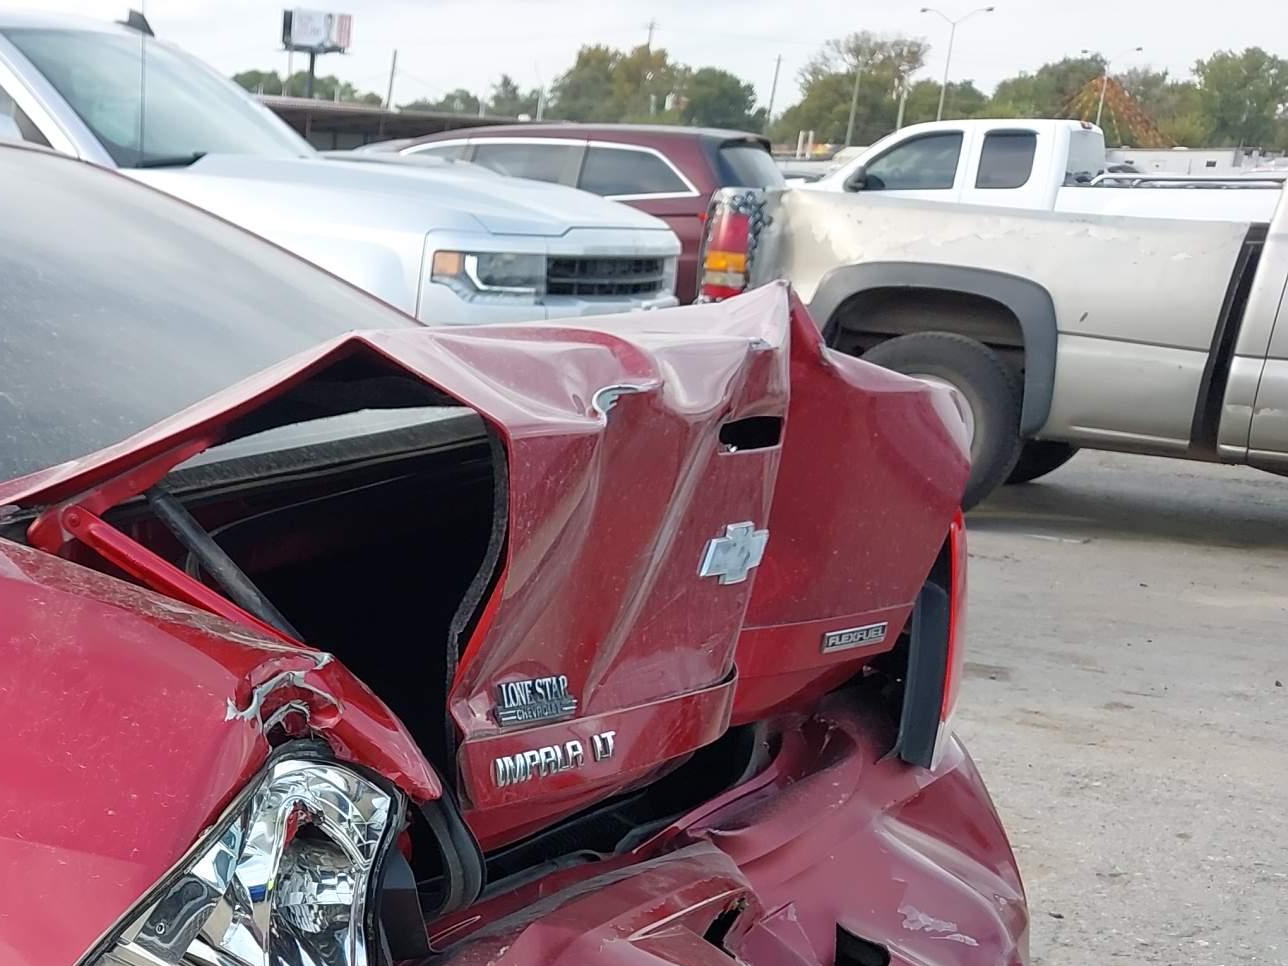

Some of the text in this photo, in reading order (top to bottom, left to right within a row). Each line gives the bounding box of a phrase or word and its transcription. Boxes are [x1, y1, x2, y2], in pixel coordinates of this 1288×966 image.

[827, 624, 883, 647] FLEXFUEL
[500, 675, 569, 709] LONE STAR
[494, 730, 616, 788] IMPALA LT
